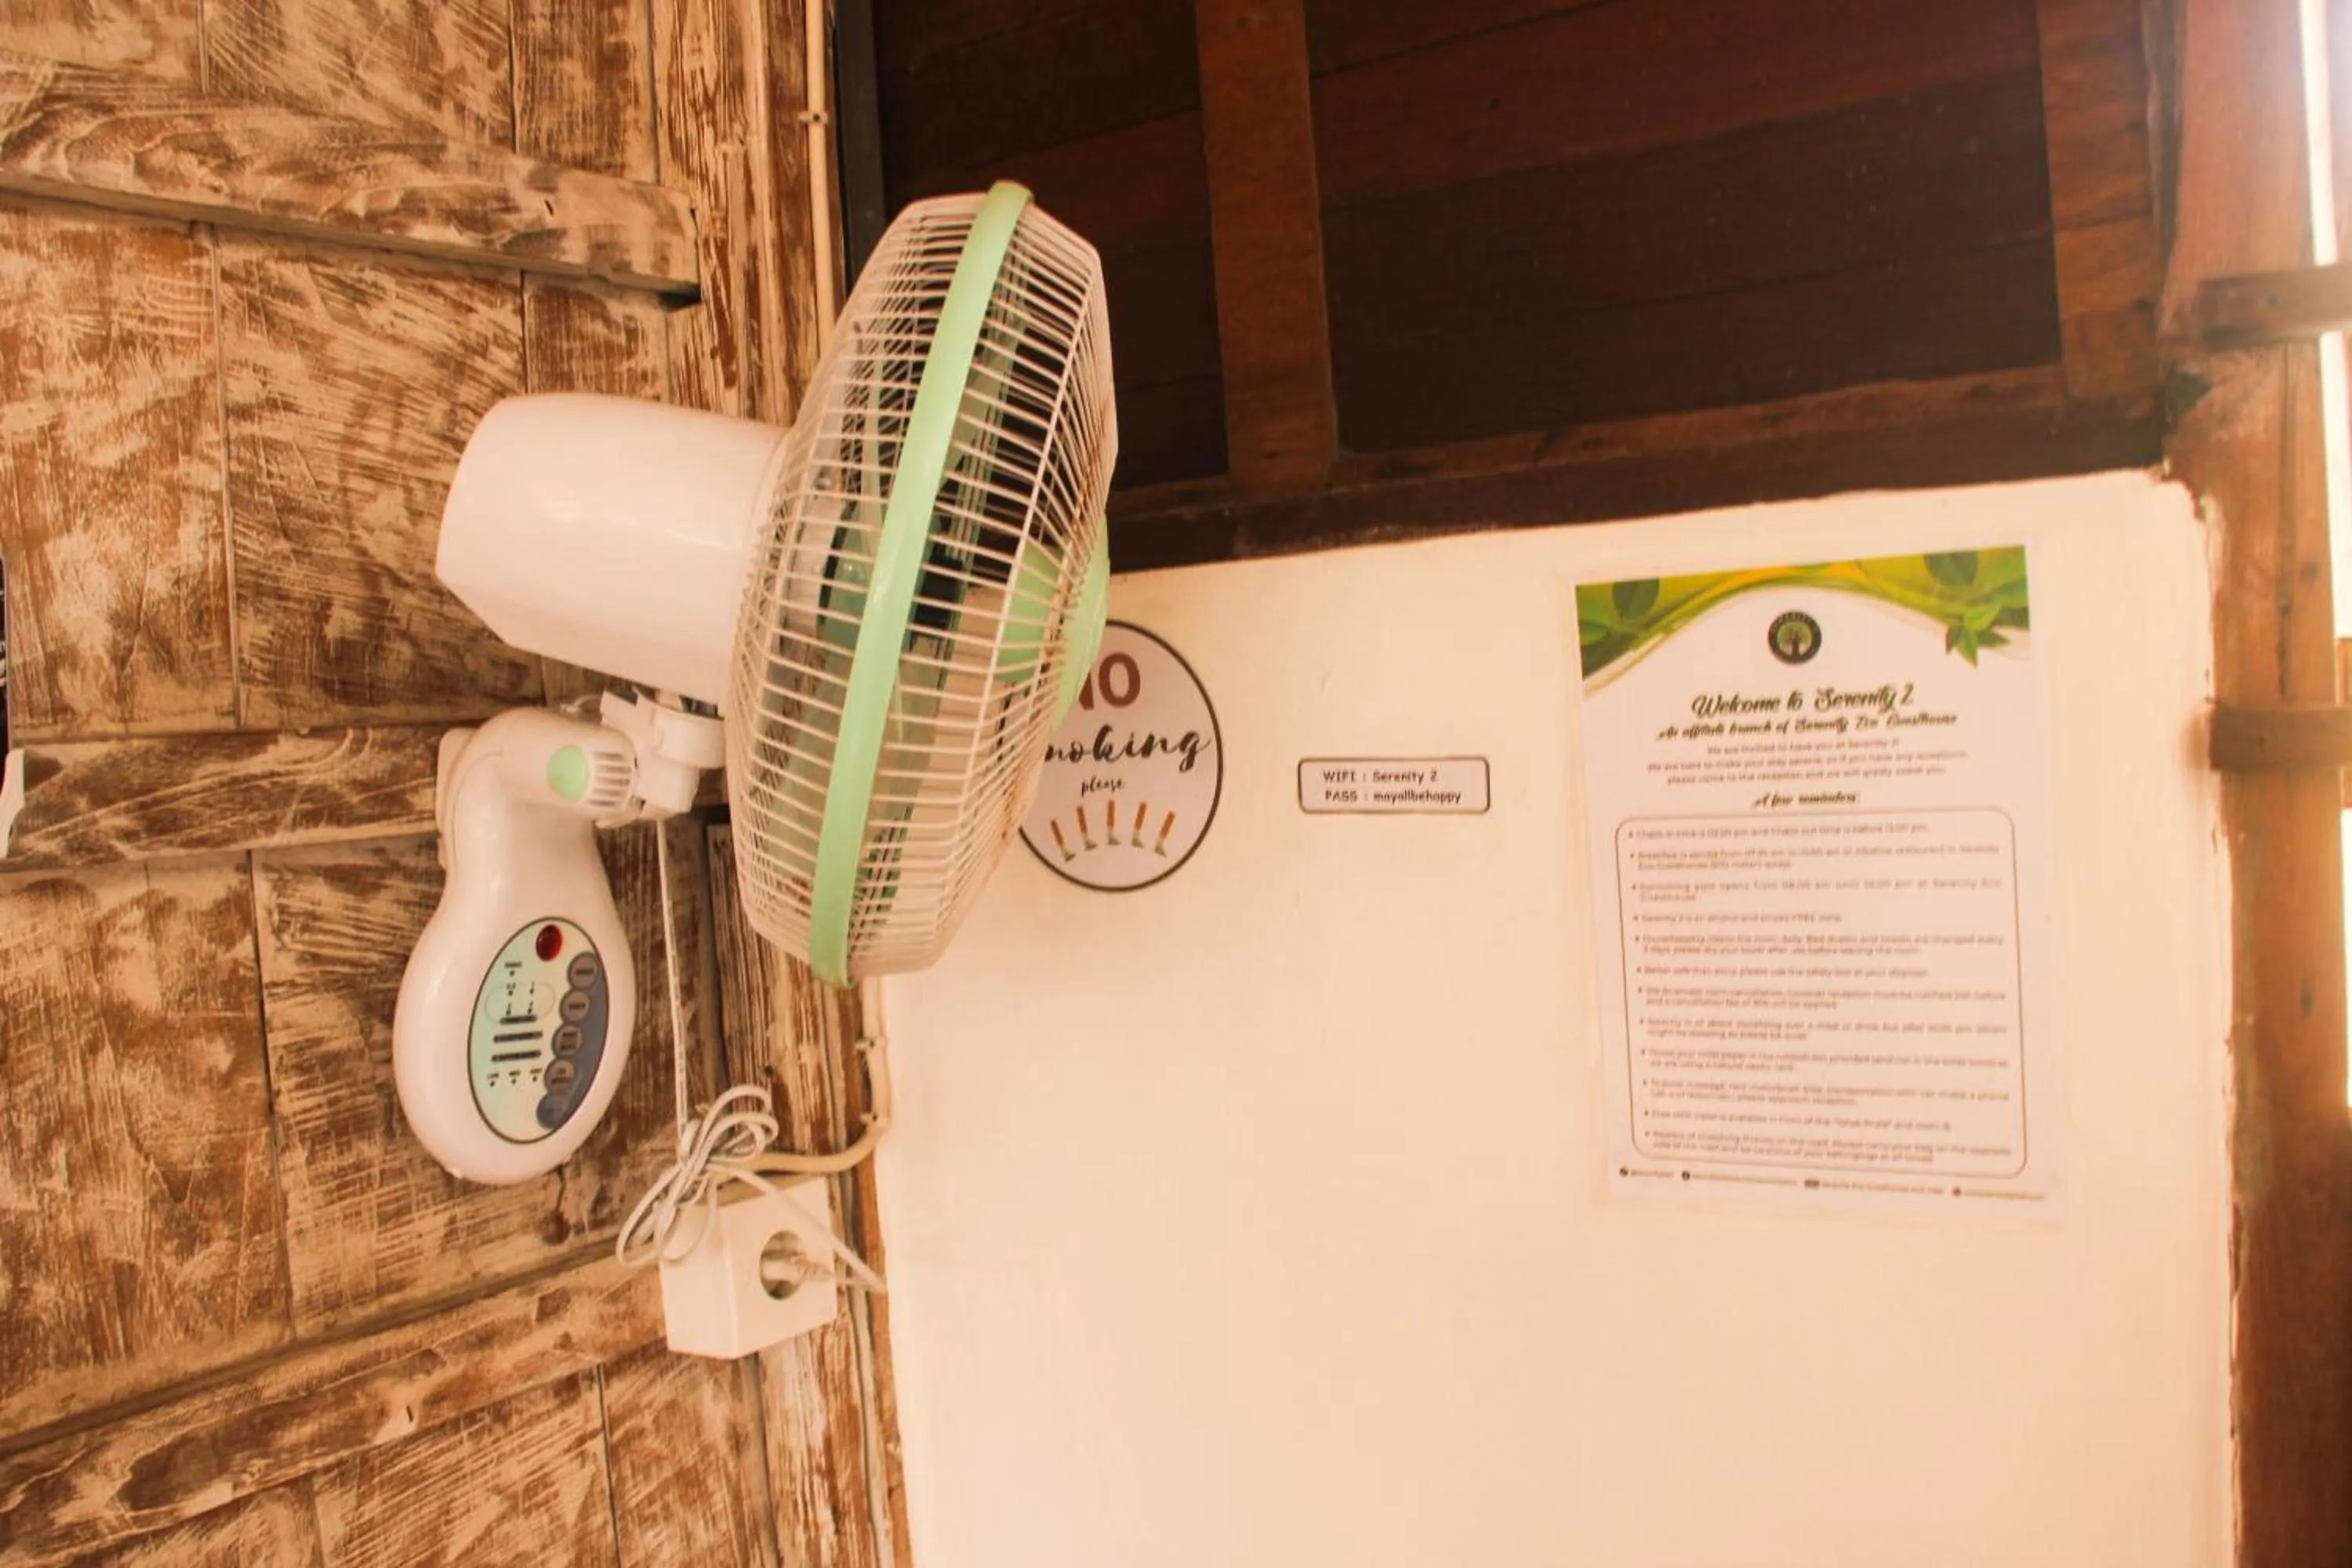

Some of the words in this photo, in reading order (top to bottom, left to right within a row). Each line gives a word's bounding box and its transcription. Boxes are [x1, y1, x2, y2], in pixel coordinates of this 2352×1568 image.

[1079, 652, 1141, 711] O
[1691, 692, 1781, 718] Welcome
[1786, 690, 1804, 711] to
[1814, 684, 1897, 714] Serenity
[1900, 682, 1915, 706] 2
[1080, 773, 1127, 798] please
[1323, 770, 1356, 783] WIFI
[1372, 768, 1425, 785] Serenity
[1429, 770, 1439, 782] 2
[1325, 789, 1358, 803] PASS
[1374, 789, 1462, 806] mayallbehappy
